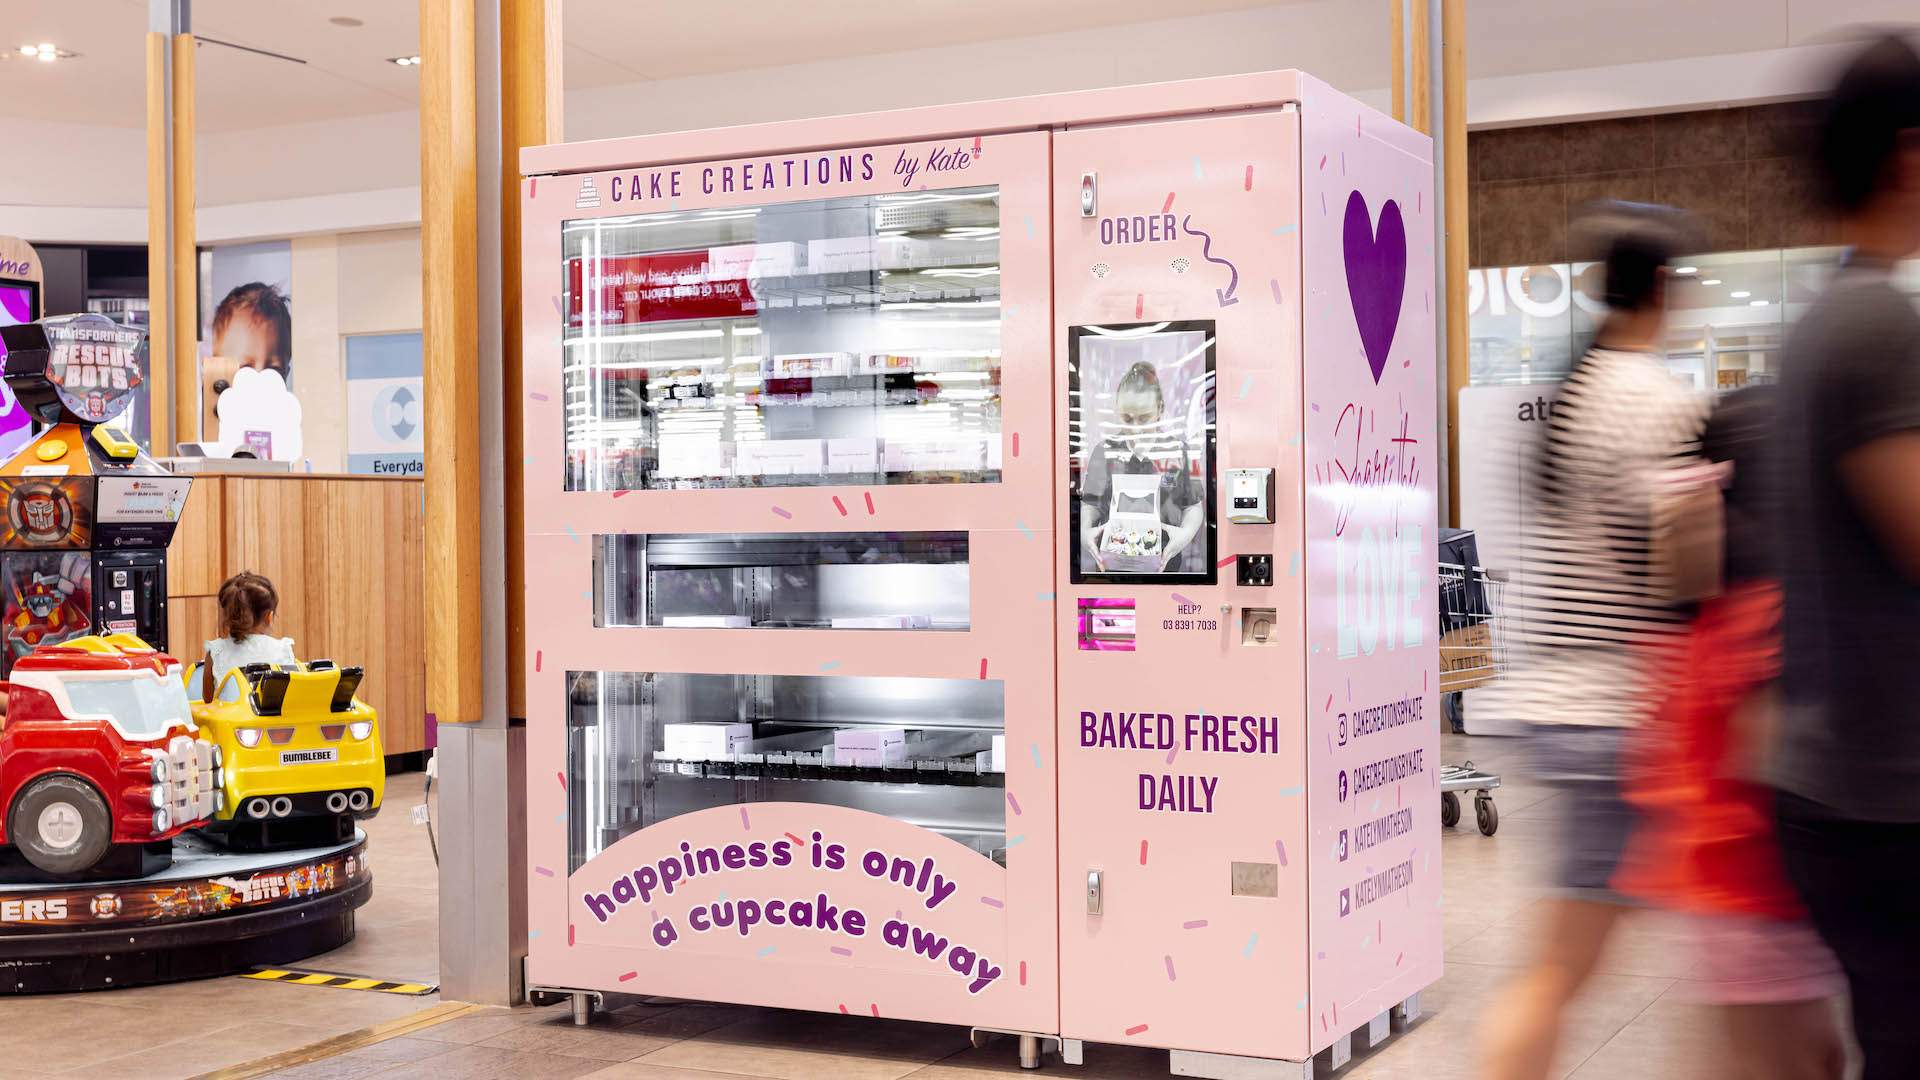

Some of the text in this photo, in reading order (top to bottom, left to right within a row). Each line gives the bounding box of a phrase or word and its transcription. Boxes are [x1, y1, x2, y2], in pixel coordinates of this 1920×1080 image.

[611, 171, 682, 202] CAKE
[702, 153, 875, 195] CREATIONS
[894, 148, 920, 188] by
[1100, 213, 1177, 245] ORDER
[50, 327, 139, 343] TRANSFORMERS
[53, 344, 136, 368] RESCUE
[64, 365, 129, 390] BOTS
[1178, 604, 1202, 615] HELP?
[1335, 525, 1424, 660] LOVE
[1163, 619, 1217, 631] 03 8391 7038
[1080, 710, 1279, 755] BAKED FRESH
[1352, 696, 1424, 739] CAKECREATIONSBYKATE
[283, 750, 332, 763] BUMBLEBEE
[1352, 748, 1424, 796] CAKECREATIONSBYKATE
[1138, 773, 1219, 814] DAILY
[1353, 806, 1413, 854] KATELYNMATHESON
[583, 831, 956, 923] happiness is only
[1354, 858, 1414, 911] KATELYNMATHESON
[1, 898, 68, 921] ERS
[652, 892, 1002, 994] a cupcake away
